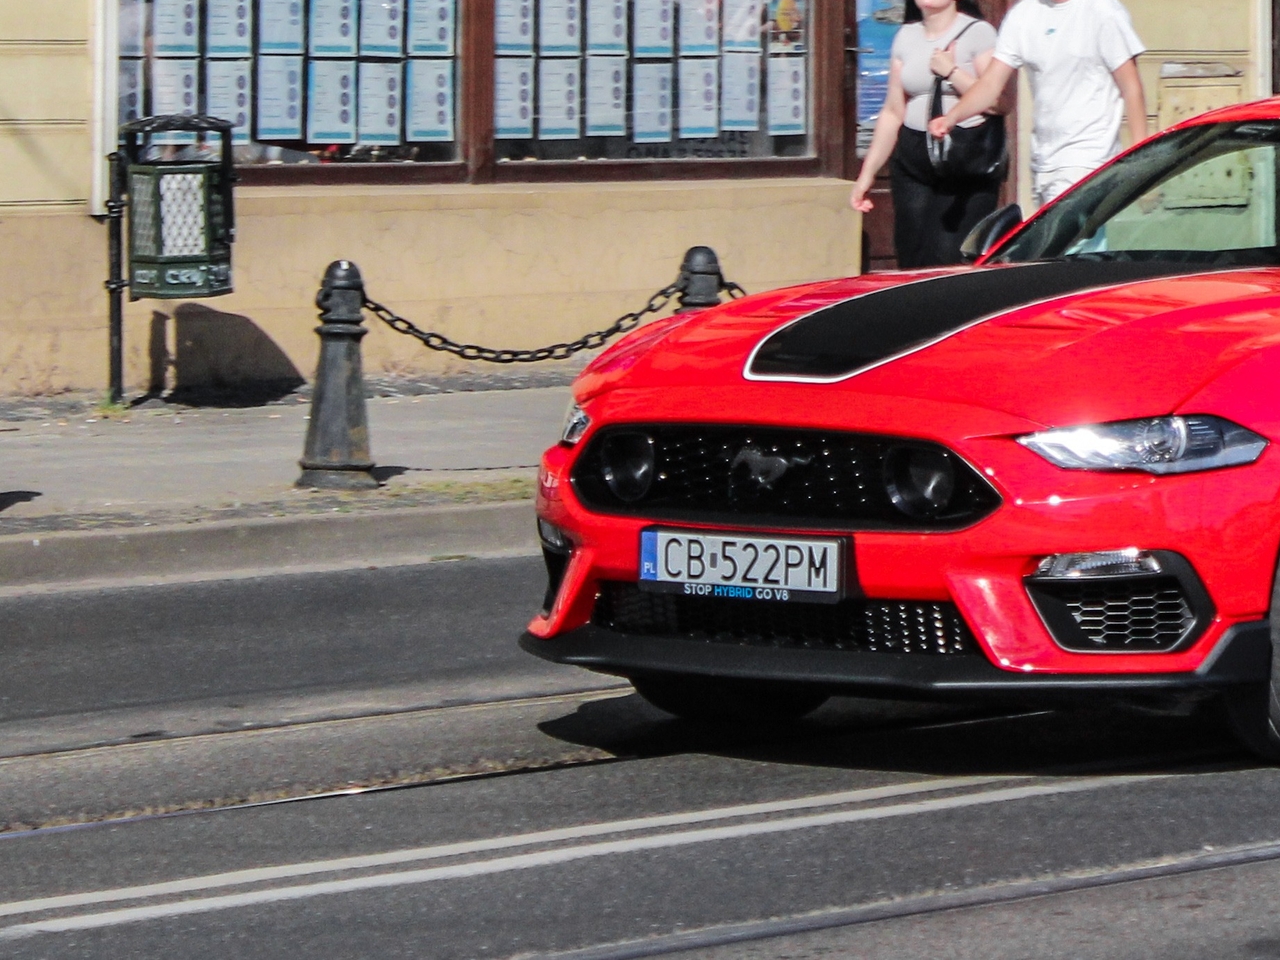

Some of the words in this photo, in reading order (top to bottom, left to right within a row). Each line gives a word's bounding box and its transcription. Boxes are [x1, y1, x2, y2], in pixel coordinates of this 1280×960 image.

[644, 562, 655, 573] PL
[664, 538, 705, 579] CB
[721, 541, 828, 588] 522PM
[684, 583, 712, 595] STOP
[714, 585, 753, 599] HYBRID
[755, 589, 771, 600] GO
[774, 590, 789, 601] V8
